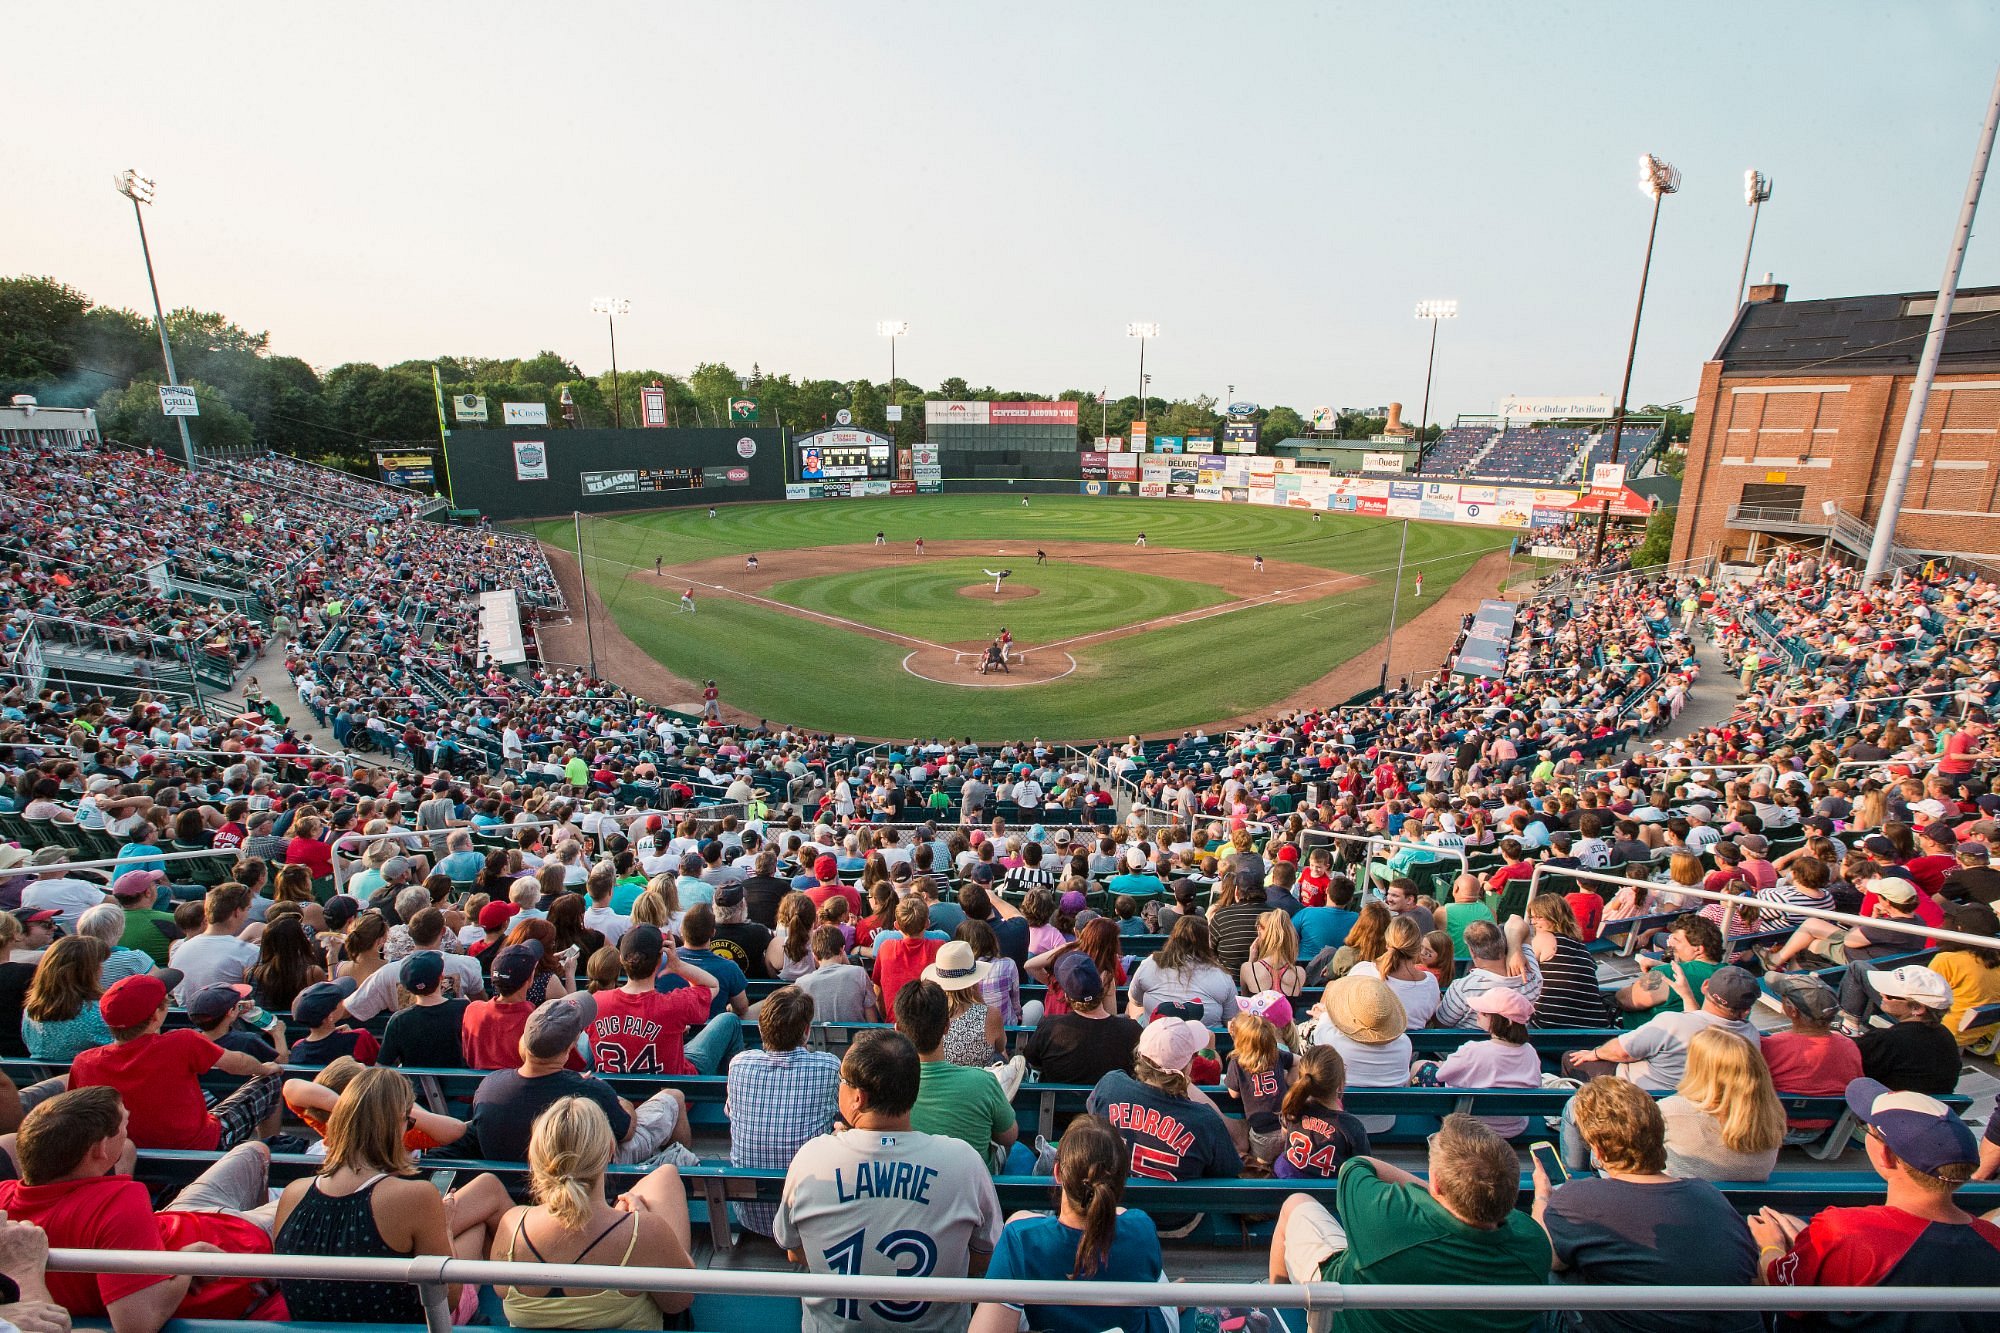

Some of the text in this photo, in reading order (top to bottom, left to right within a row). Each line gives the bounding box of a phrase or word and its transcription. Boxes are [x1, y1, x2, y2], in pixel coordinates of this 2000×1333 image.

[160, 386, 195, 396] SHIPYARD
[164, 398, 195, 406] GRILL
[1030, 409, 1058, 417] AROUND
[1060, 409, 1076, 417] YOU.
[1533, 404, 1567, 413] Cellular
[1570, 404, 1605, 414] Pavilion
[1372, 435, 1403, 443] L.L.Bean
[1168, 460, 1198, 468] DELIVER
[1364, 457, 1399, 466] SymQuest
[729, 471, 746, 479] Hood
[1194, 487, 1221, 495] MACPAGE
[1592, 488, 1619, 498] AAA.com
[1591, 843, 1606, 853] JETER
[1598, 855, 1608, 868] 2
[730, 943, 745, 960] VETS
[595, 1015, 662, 1042] BIG PAPI
[595, 1041, 664, 1075] 34
[1251, 1070, 1283, 1097] 15
[1108, 1102, 1195, 1158] PEDROIA
[1301, 1113, 1336, 1140] ORTIZ
[1286, 1130, 1336, 1178] 34
[835, 1160, 939, 1206] LAWRIE
[822, 1226, 938, 1324] 13
